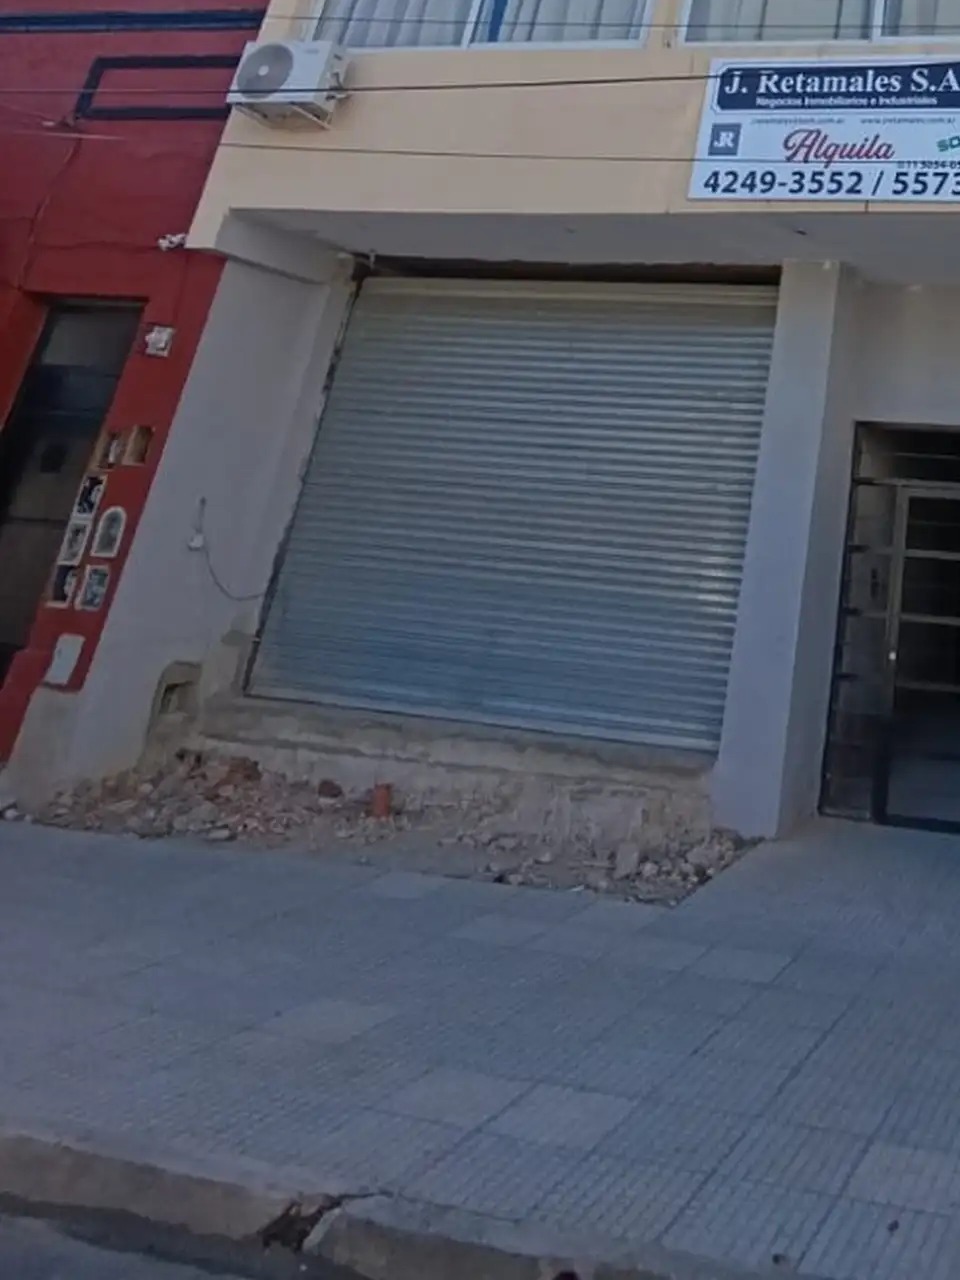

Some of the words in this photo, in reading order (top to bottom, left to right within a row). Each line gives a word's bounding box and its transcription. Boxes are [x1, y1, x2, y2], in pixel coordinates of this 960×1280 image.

[724, 71, 748, 94] J.
[756, 69, 902, 95] Retamales
[756, 96, 801, 108] Negocios
[713, 131, 734, 149] JR
[783, 128, 895, 169] Alquila
[703, 170, 862, 196] 4249-3552
[871, 169, 885, 197] /
